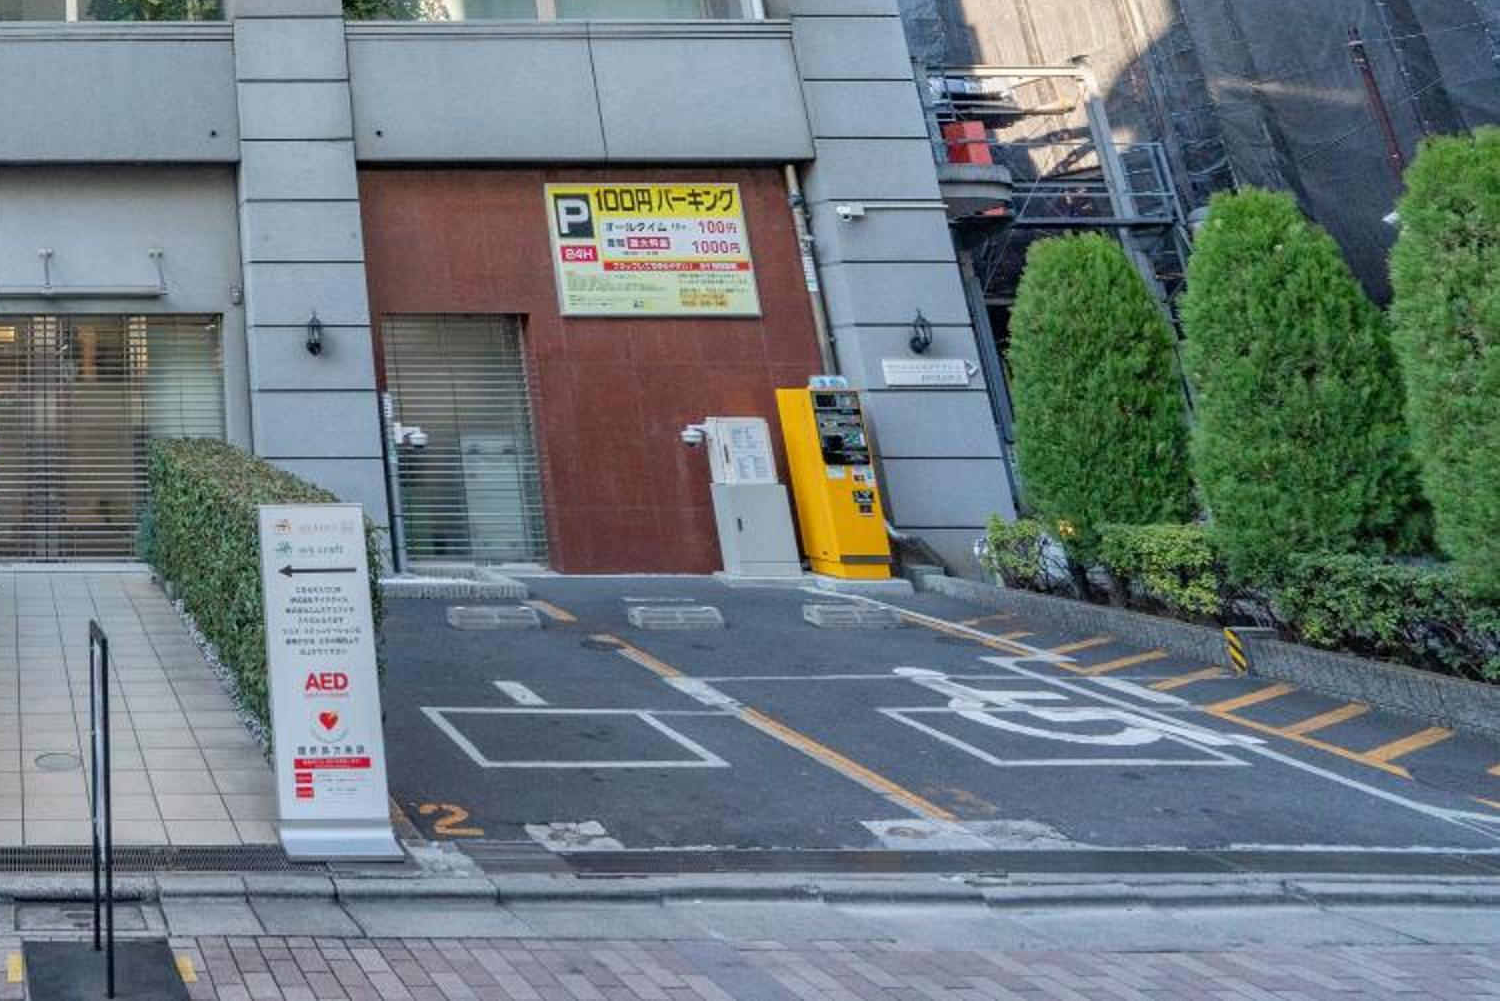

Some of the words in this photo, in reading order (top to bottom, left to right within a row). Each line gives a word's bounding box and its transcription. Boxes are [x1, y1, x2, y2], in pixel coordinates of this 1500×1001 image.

[595, 188, 735, 212] 100円パーキング
[557, 198, 590, 234] P
[698, 220, 738, 234] 100円
[565, 248, 594, 260] 24H
[692, 240, 741, 254] 1000円
[304, 672, 349, 691] AED
[419, 803, 485, 837] 2
